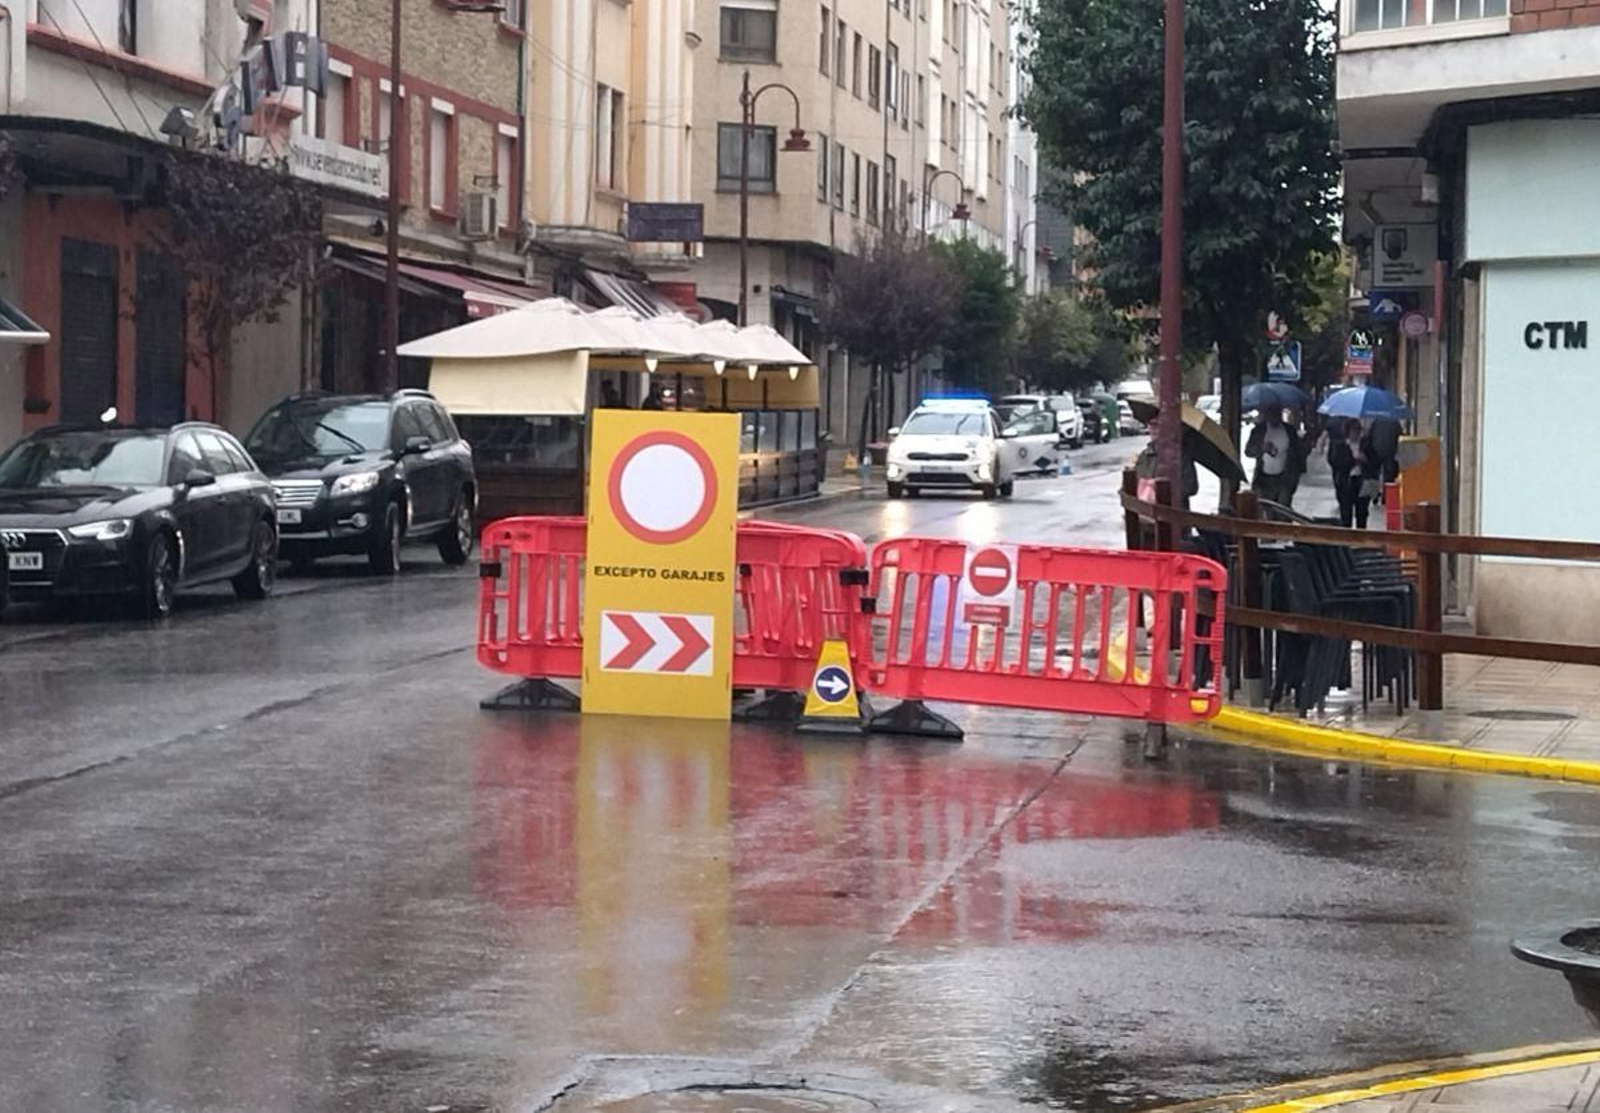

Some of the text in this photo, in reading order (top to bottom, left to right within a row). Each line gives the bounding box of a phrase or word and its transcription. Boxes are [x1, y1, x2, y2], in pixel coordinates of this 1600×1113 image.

[1524, 320, 1588, 350] CTM
[594, 565, 726, 582] EXCEPTO GARAJES
